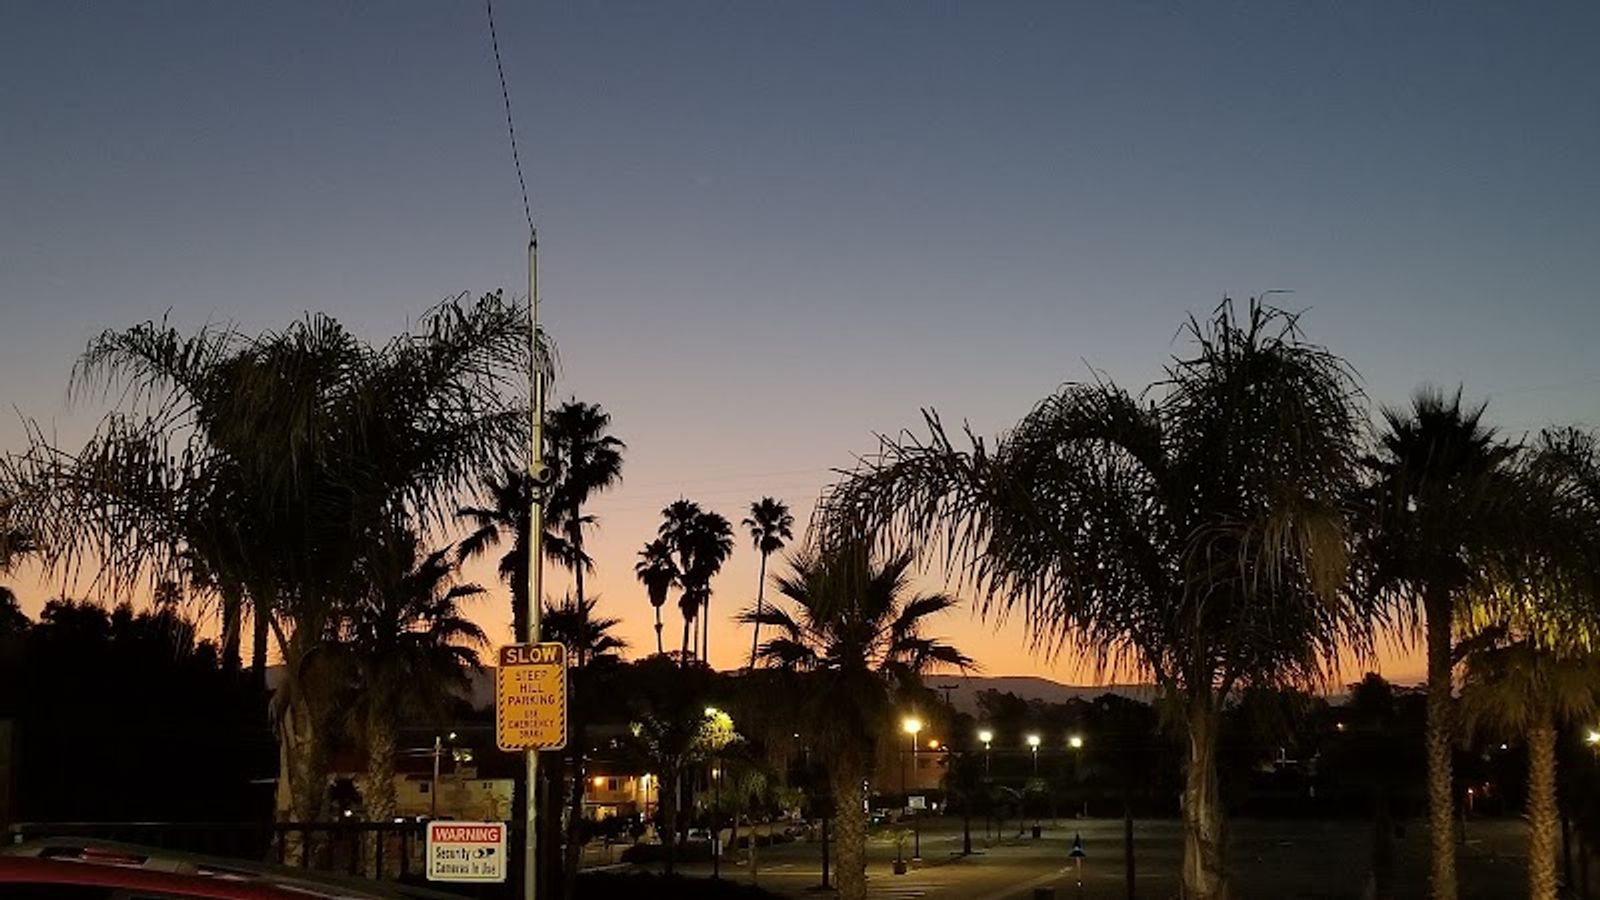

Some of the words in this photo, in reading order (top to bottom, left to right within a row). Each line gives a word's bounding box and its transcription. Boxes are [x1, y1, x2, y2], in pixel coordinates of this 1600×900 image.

[506, 647, 557, 663] SLOW
[515, 670, 547, 681] STEEP
[520, 683, 544, 693] HILL
[507, 695, 555, 705] PARKING
[435, 828, 498, 841] WARNING
[436, 846, 470, 860] Security
[436, 862, 469, 873] Cameras
